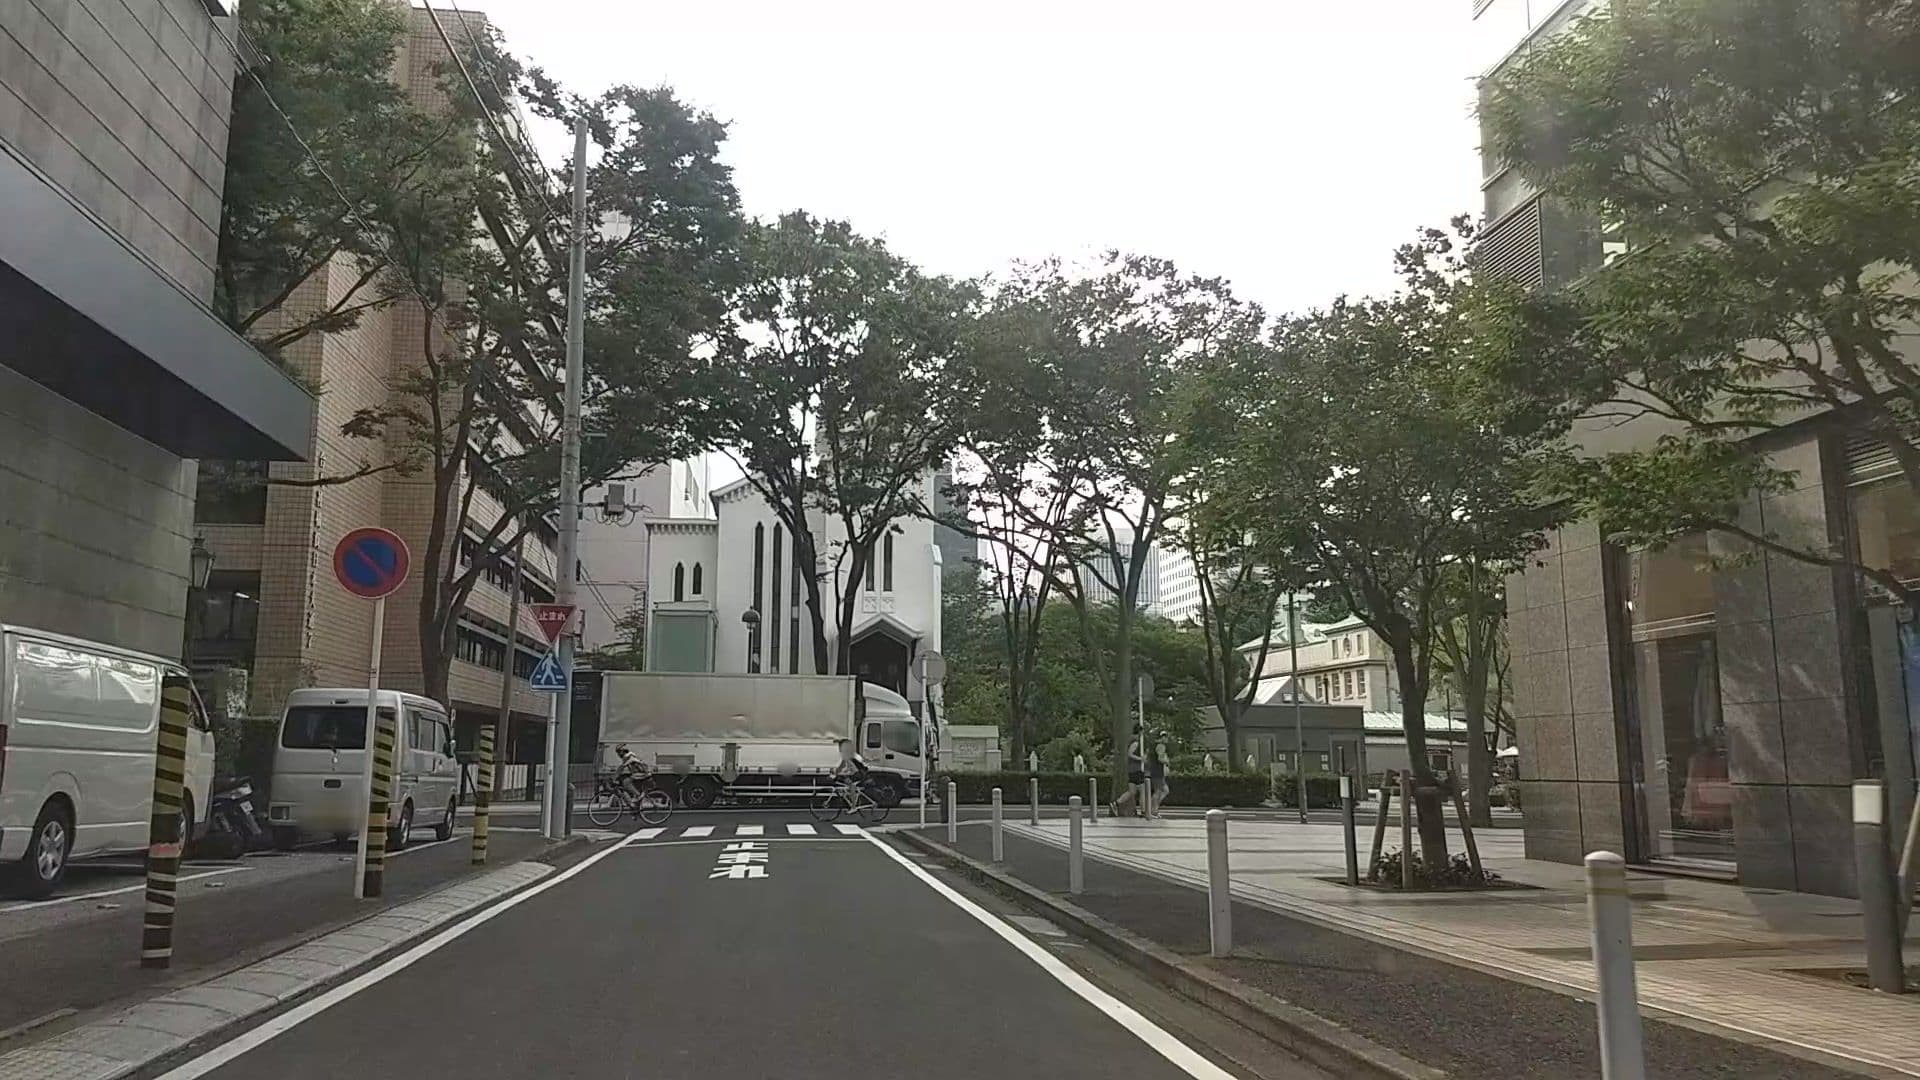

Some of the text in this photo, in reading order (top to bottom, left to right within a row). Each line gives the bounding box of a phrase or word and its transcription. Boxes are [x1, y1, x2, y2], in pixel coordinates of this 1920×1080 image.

[539, 611, 566, 621] 止まれ
[708, 842, 769, 879] 止まれ
